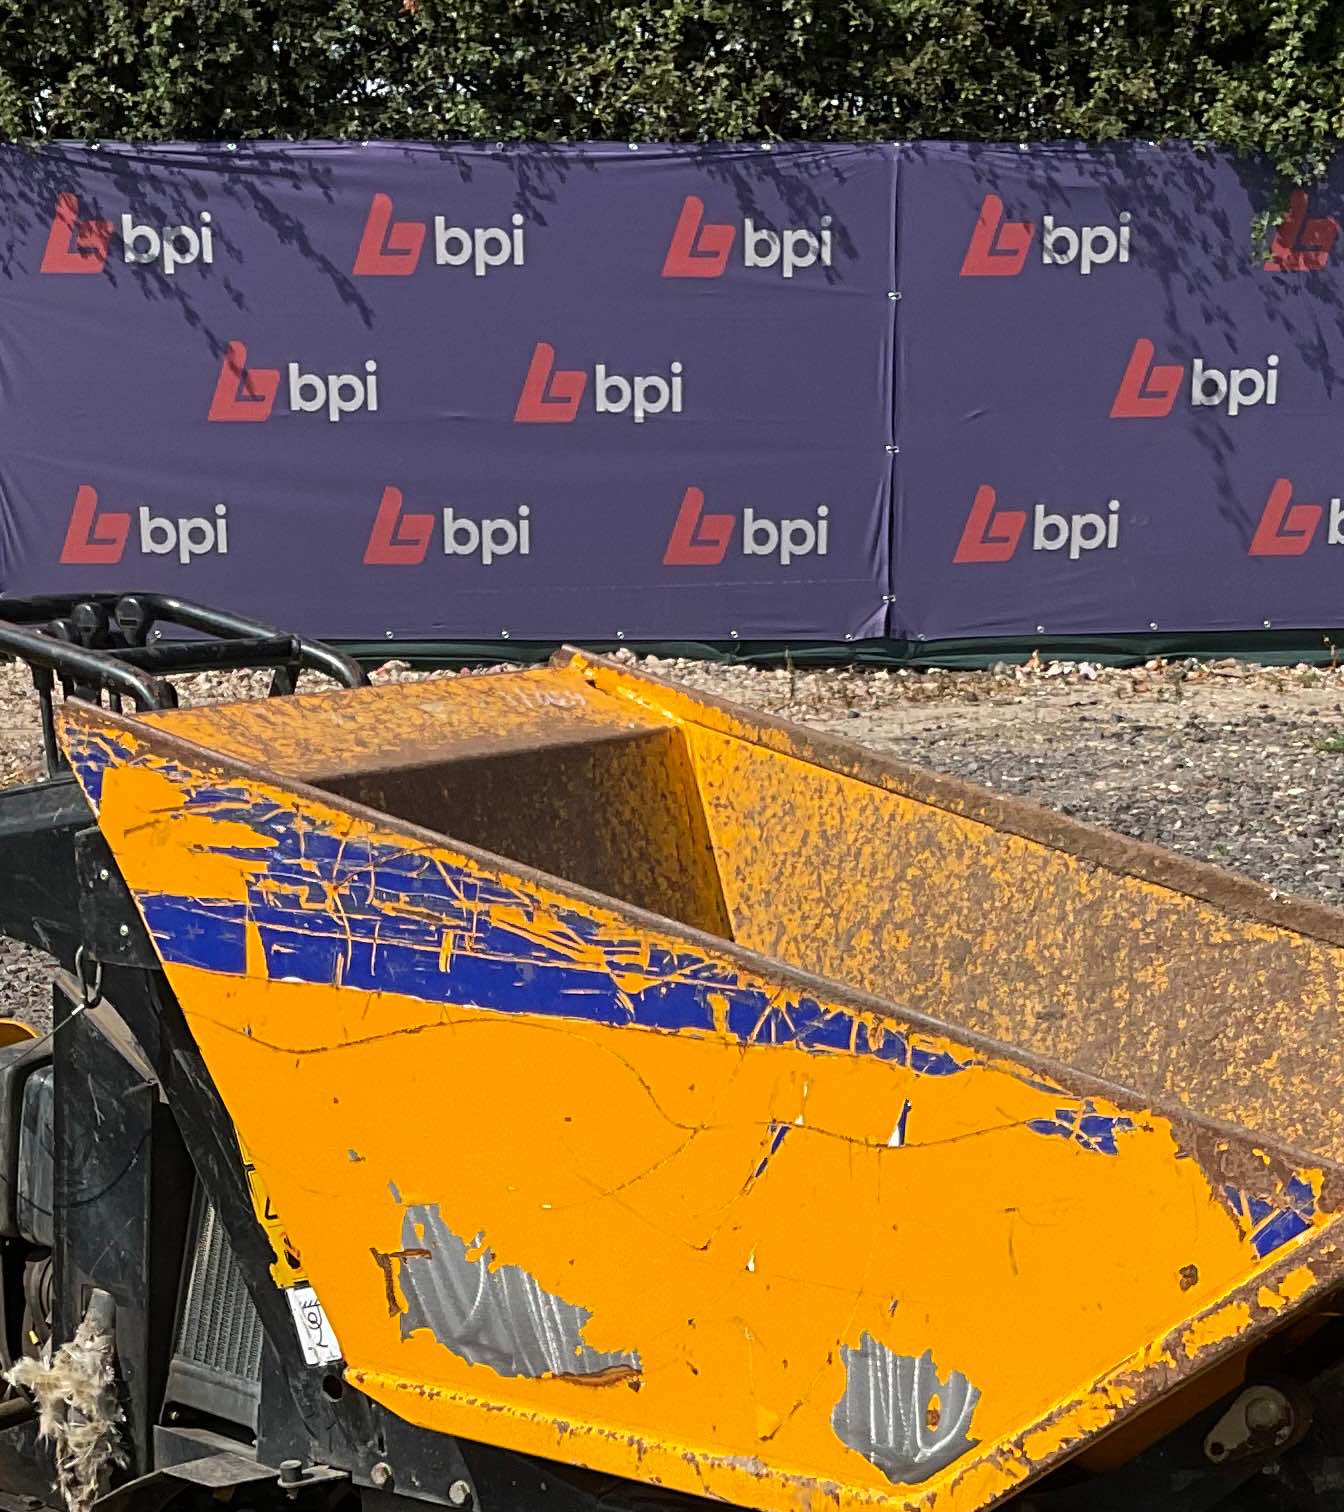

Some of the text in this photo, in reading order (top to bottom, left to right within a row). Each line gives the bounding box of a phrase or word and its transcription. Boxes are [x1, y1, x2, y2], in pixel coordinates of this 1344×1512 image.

[122, 212, 212, 274] bpi
[435, 214, 524, 275] bpi
[745, 216, 831, 277] bpi
[1043, 212, 1131, 274] bpi
[289, 360, 377, 421] bpi
[596, 362, 682, 422] bpi
[1192, 355, 1279, 415] bpi
[140, 504, 227, 563] bpi
[444, 505, 529, 564] bpi
[744, 505, 828, 564] bpi
[1034, 500, 1120, 559] bpi
